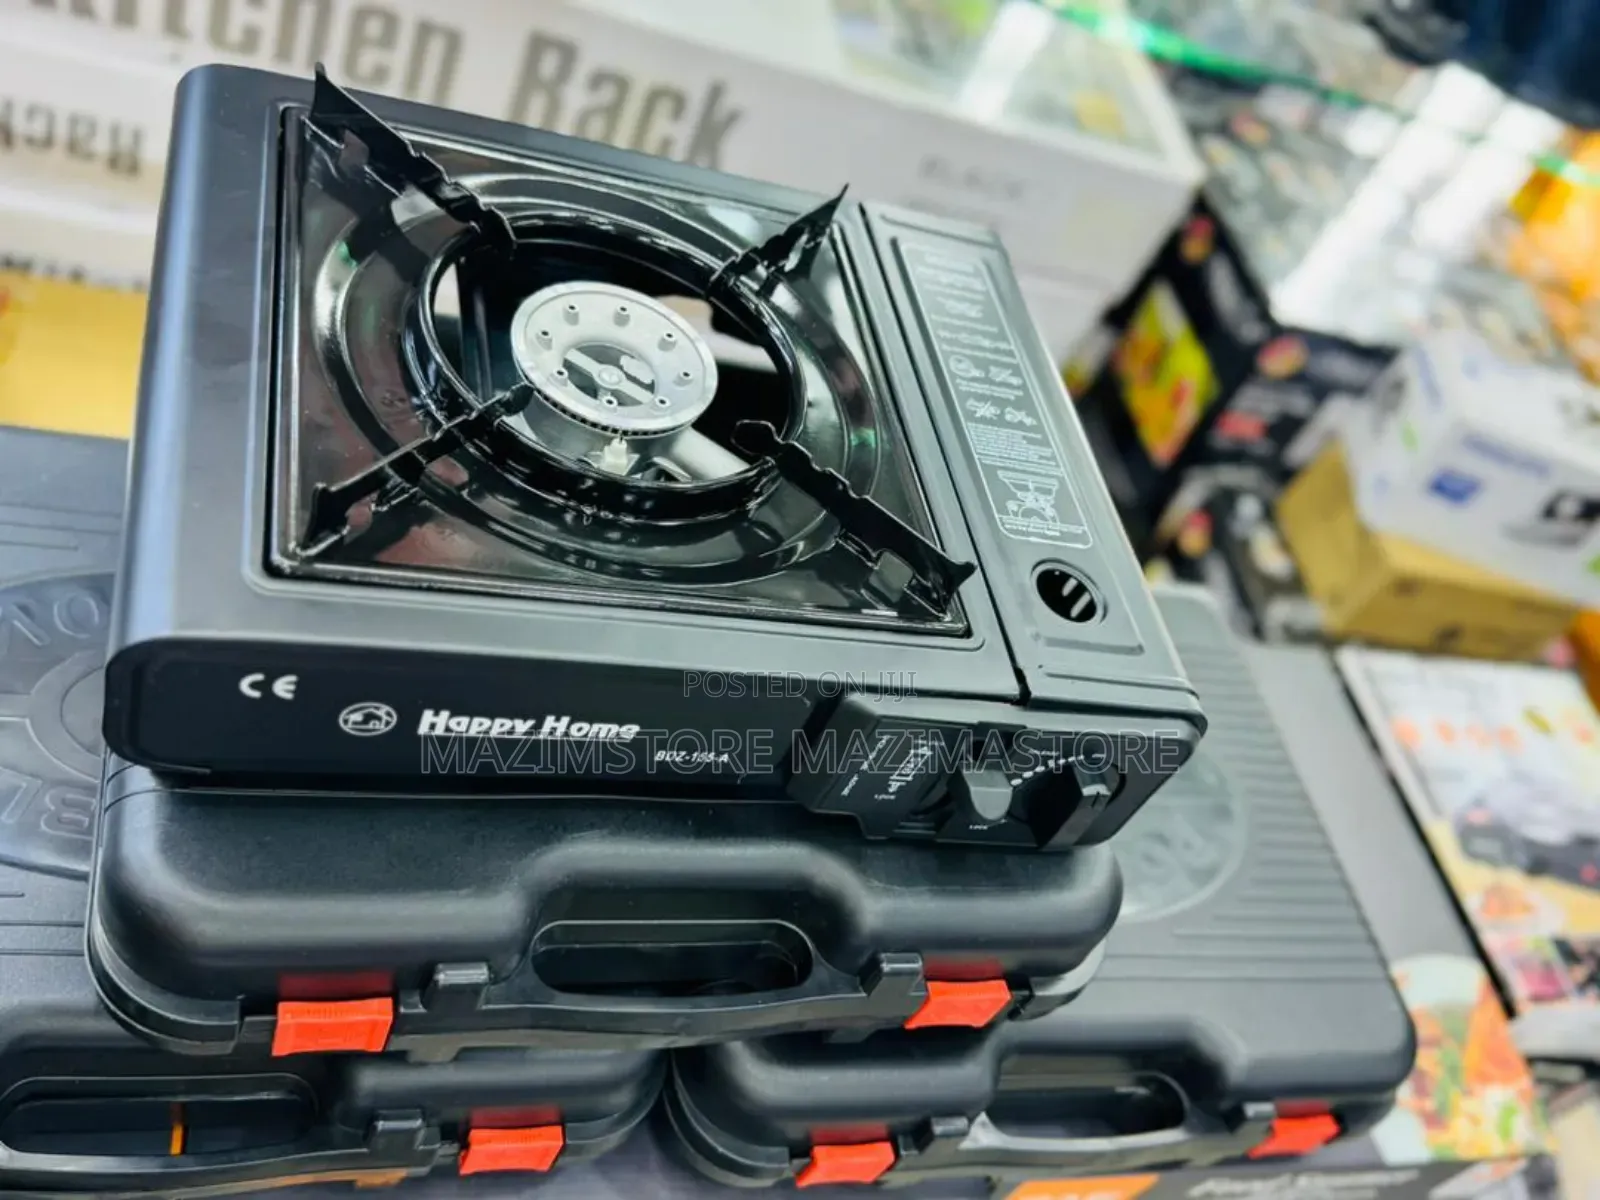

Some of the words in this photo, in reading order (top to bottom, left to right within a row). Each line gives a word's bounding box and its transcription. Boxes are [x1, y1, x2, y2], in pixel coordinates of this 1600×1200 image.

[30, 0, 467, 106] chen
[506, 29, 745, 171] Rack
[238, 672, 299, 700] CE
[417, 709, 536, 736] Happy
[540, 715, 640, 741] Home
